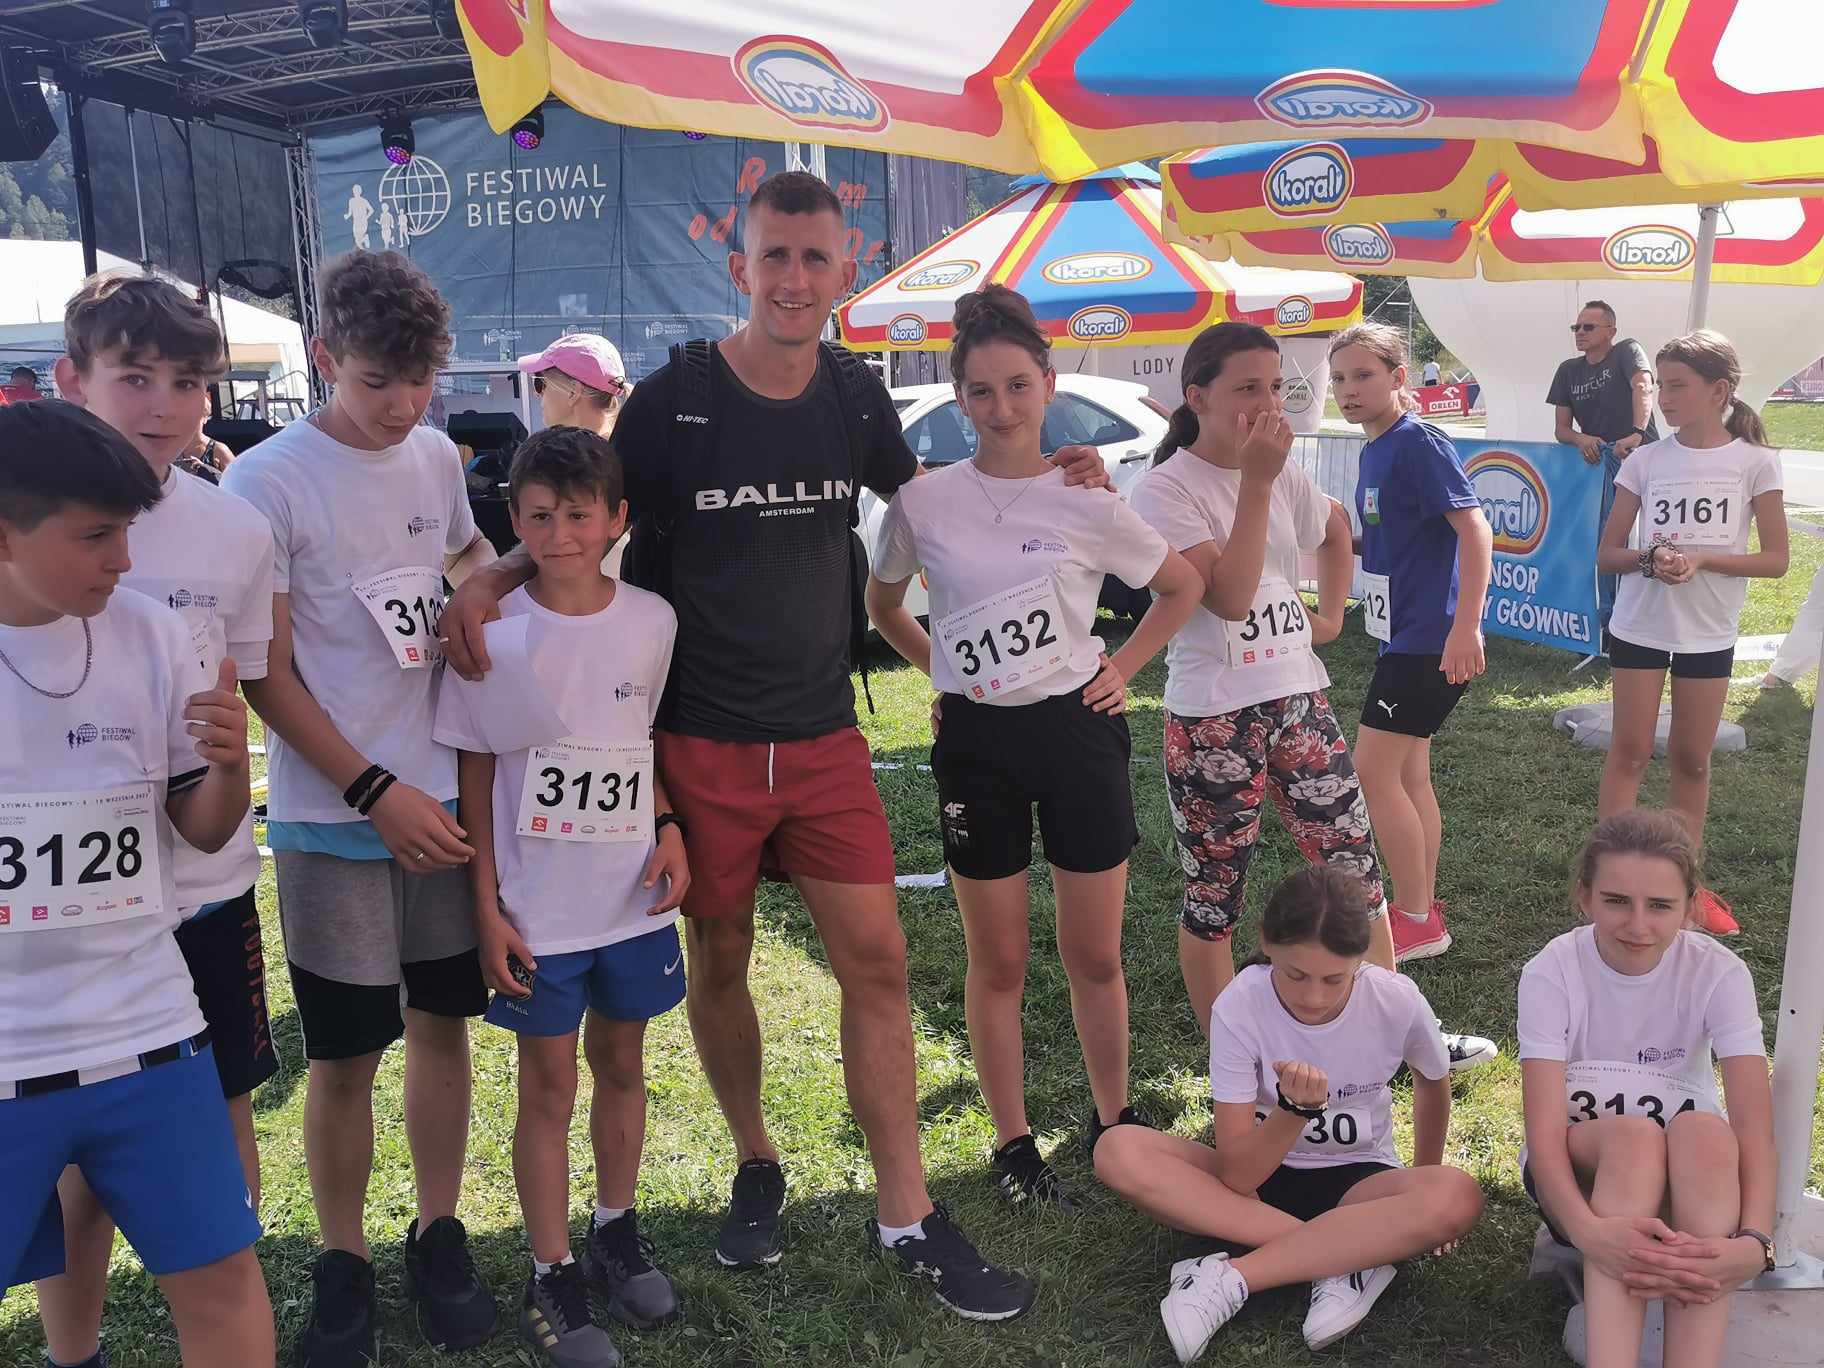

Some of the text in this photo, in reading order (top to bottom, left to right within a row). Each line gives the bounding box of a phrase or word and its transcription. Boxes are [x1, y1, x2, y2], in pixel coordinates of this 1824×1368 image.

[466, 163, 607, 196] FESTIWAL
[1276, 165, 1337, 206] koral
[467, 194, 606, 228] BIEGOWY
[910, 268, 964, 286] koral
[1060, 261, 1136, 280] koral
[1078, 317, 1122, 336] koral
[1280, 305, 1308, 324] koral
[891, 322, 921, 341] koral
[1133, 357, 1174, 376] LODY
[682, 414, 709, 424] HI-TEC
[1431, 401, 1459, 410] ORLEN
[695, 478, 854, 512] BALLIN
[759, 507, 815, 517] AMSTERDAM
[1475, 487, 1531, 536] oral
[1653, 497, 1729, 526] 3161
[384, 596, 444, 638] 313
[1240, 600, 1305, 641] 3129
[1364, 591, 1387, 620] 12
[1496, 595, 1592, 643] GŁÓWNEJ
[955, 609, 1057, 676] 3132
[536, 766, 640, 812] 3131
[0, 826, 142, 890] 3128
